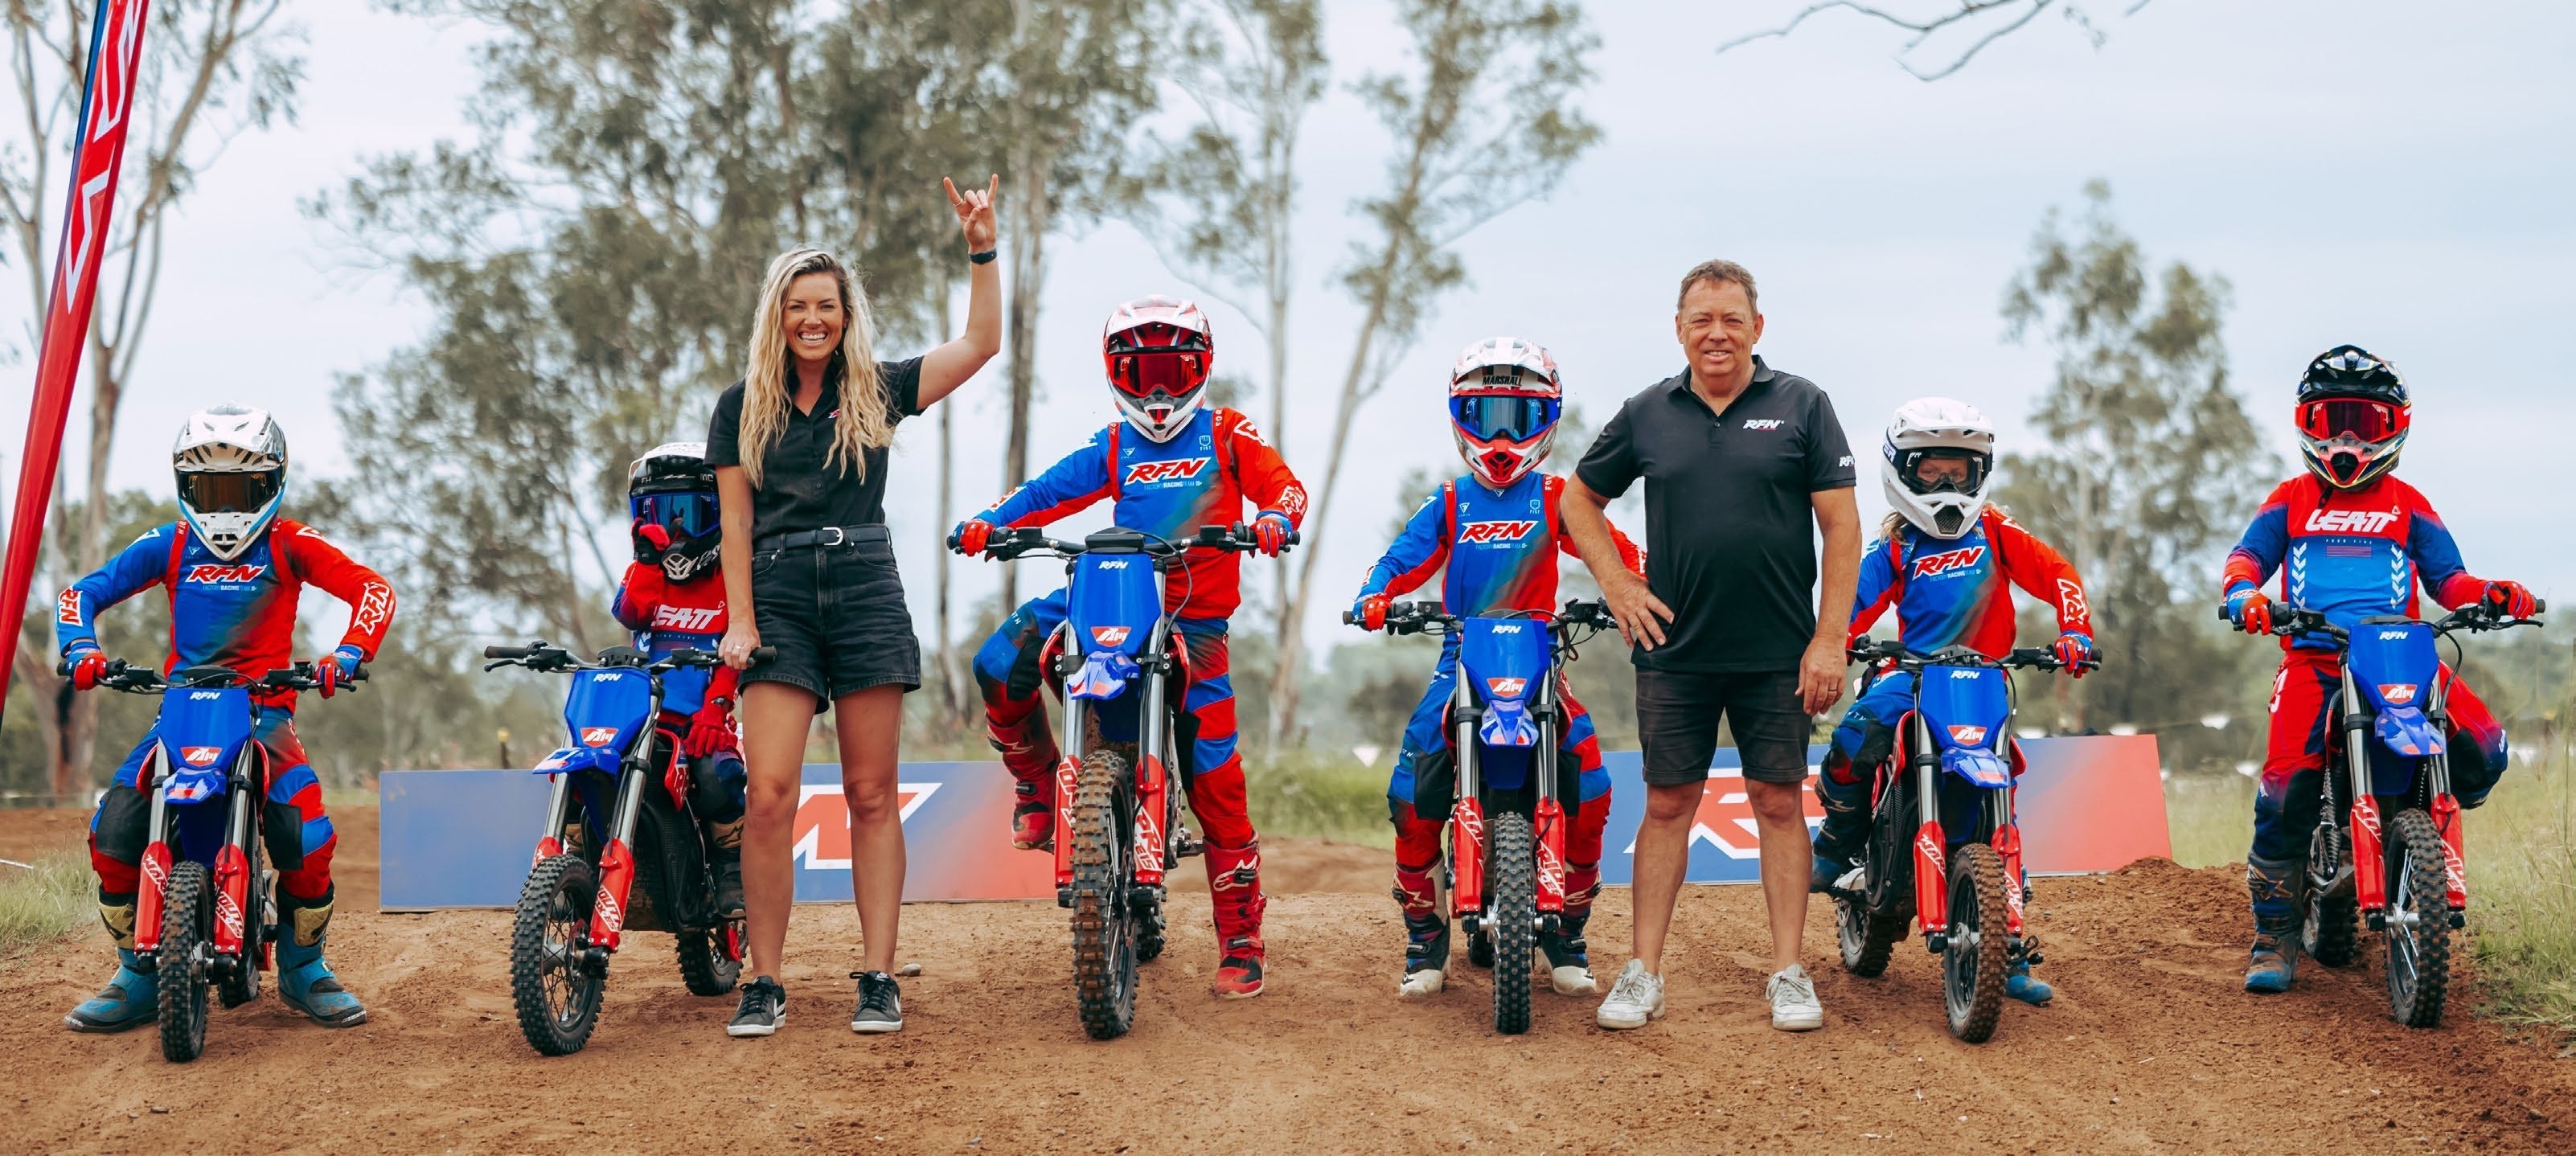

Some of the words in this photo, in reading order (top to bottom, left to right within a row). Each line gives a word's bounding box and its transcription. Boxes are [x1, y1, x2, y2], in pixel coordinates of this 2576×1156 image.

[1482, 375, 1523, 387] MARSHALL
[1743, 419, 1782, 430] RFN
[1124, 457, 1212, 486] RFN
[2305, 509, 2398, 533] LEATT
[1458, 520, 1539, 543] RFN
[1099, 560, 1129, 570] RFN
[1911, 546, 1986, 581] RFN
[185, 564, 268, 584] RFN
[58, 585, 83, 627] RFN
[354, 582, 391, 636] RFN
[1492, 625, 1522, 633] RFN
[2379, 630, 2408, 641] RFN
[593, 673, 623, 683] RFN
[1950, 670, 1980, 679] RFN
[190, 691, 221, 701] RFN
